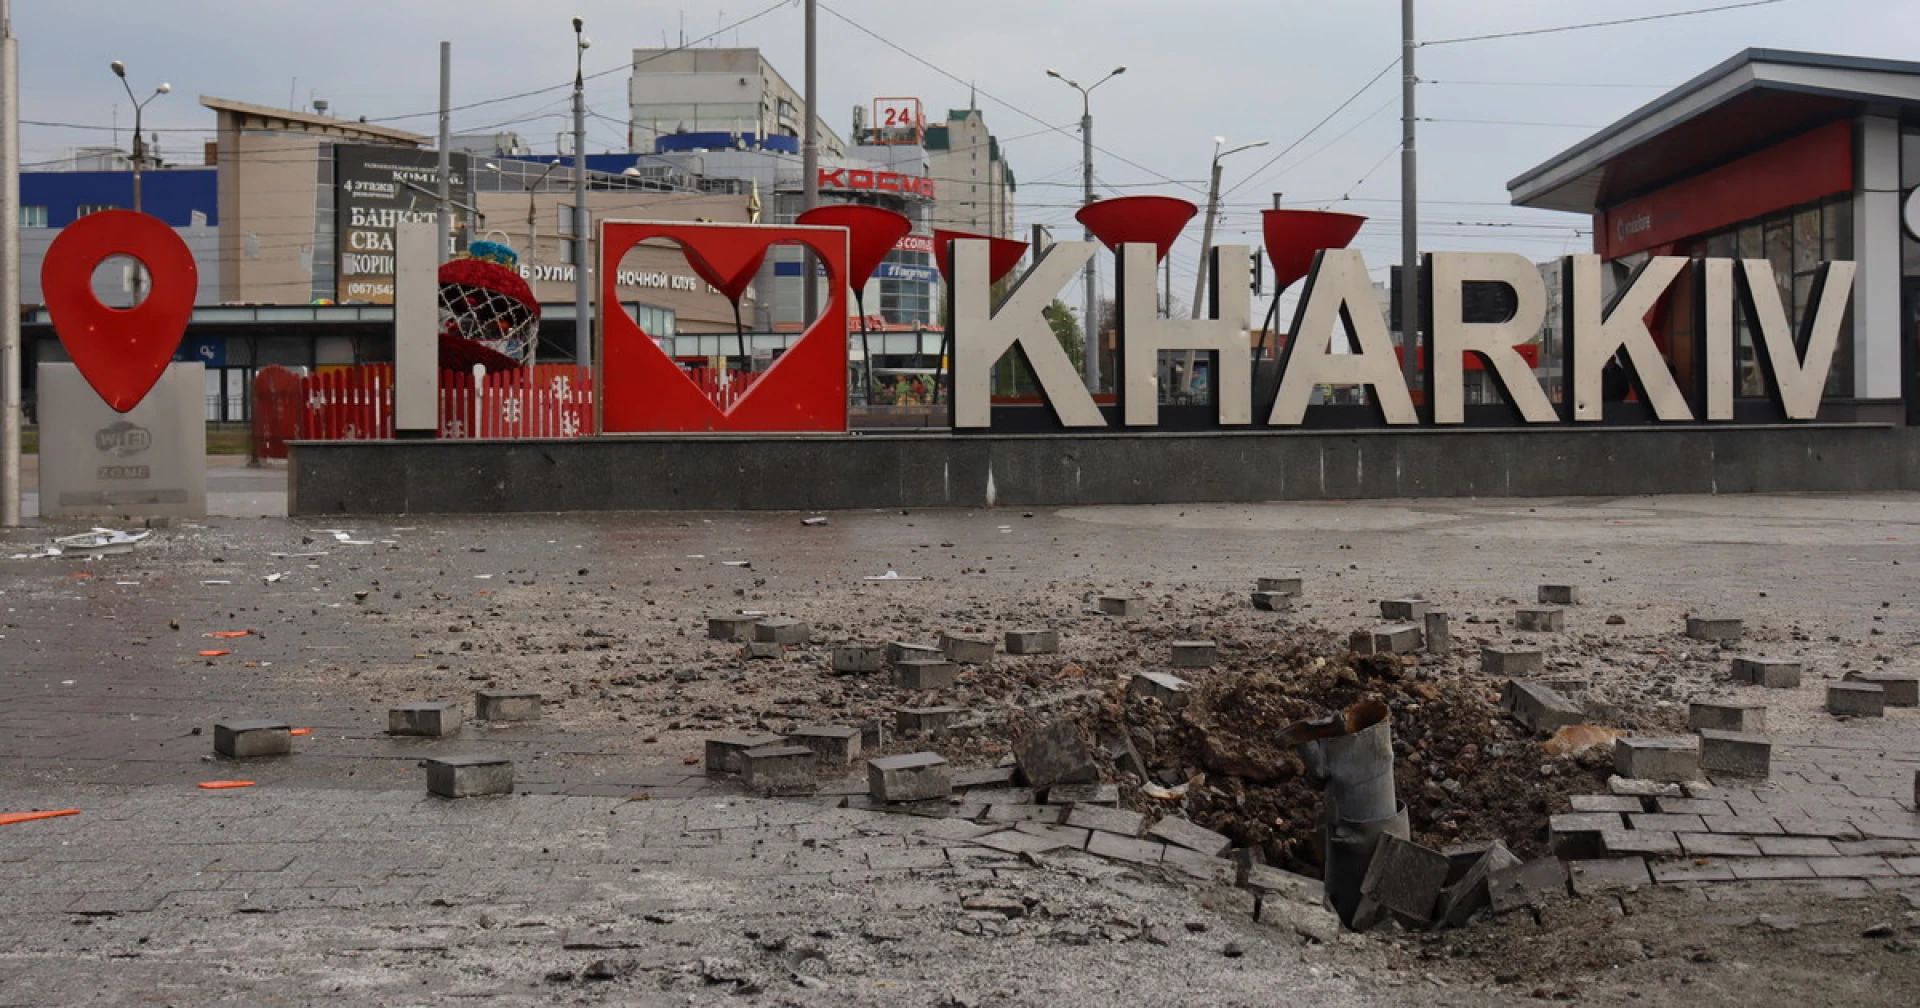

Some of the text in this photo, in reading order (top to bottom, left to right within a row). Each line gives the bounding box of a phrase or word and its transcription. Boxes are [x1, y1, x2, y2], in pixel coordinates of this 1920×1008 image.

[884, 107, 910, 126] 24
[343, 178, 353, 192] 4
[351, 207, 457, 232] БАНКЕТ
[351, 254, 394, 275] КОРП
[519, 265, 593, 282] БОУЛИ
[617, 270, 668, 288] НОЧНОЙ
[671, 275, 697, 291] КЛУБ
[953, 237, 1857, 427] KHARKIV
